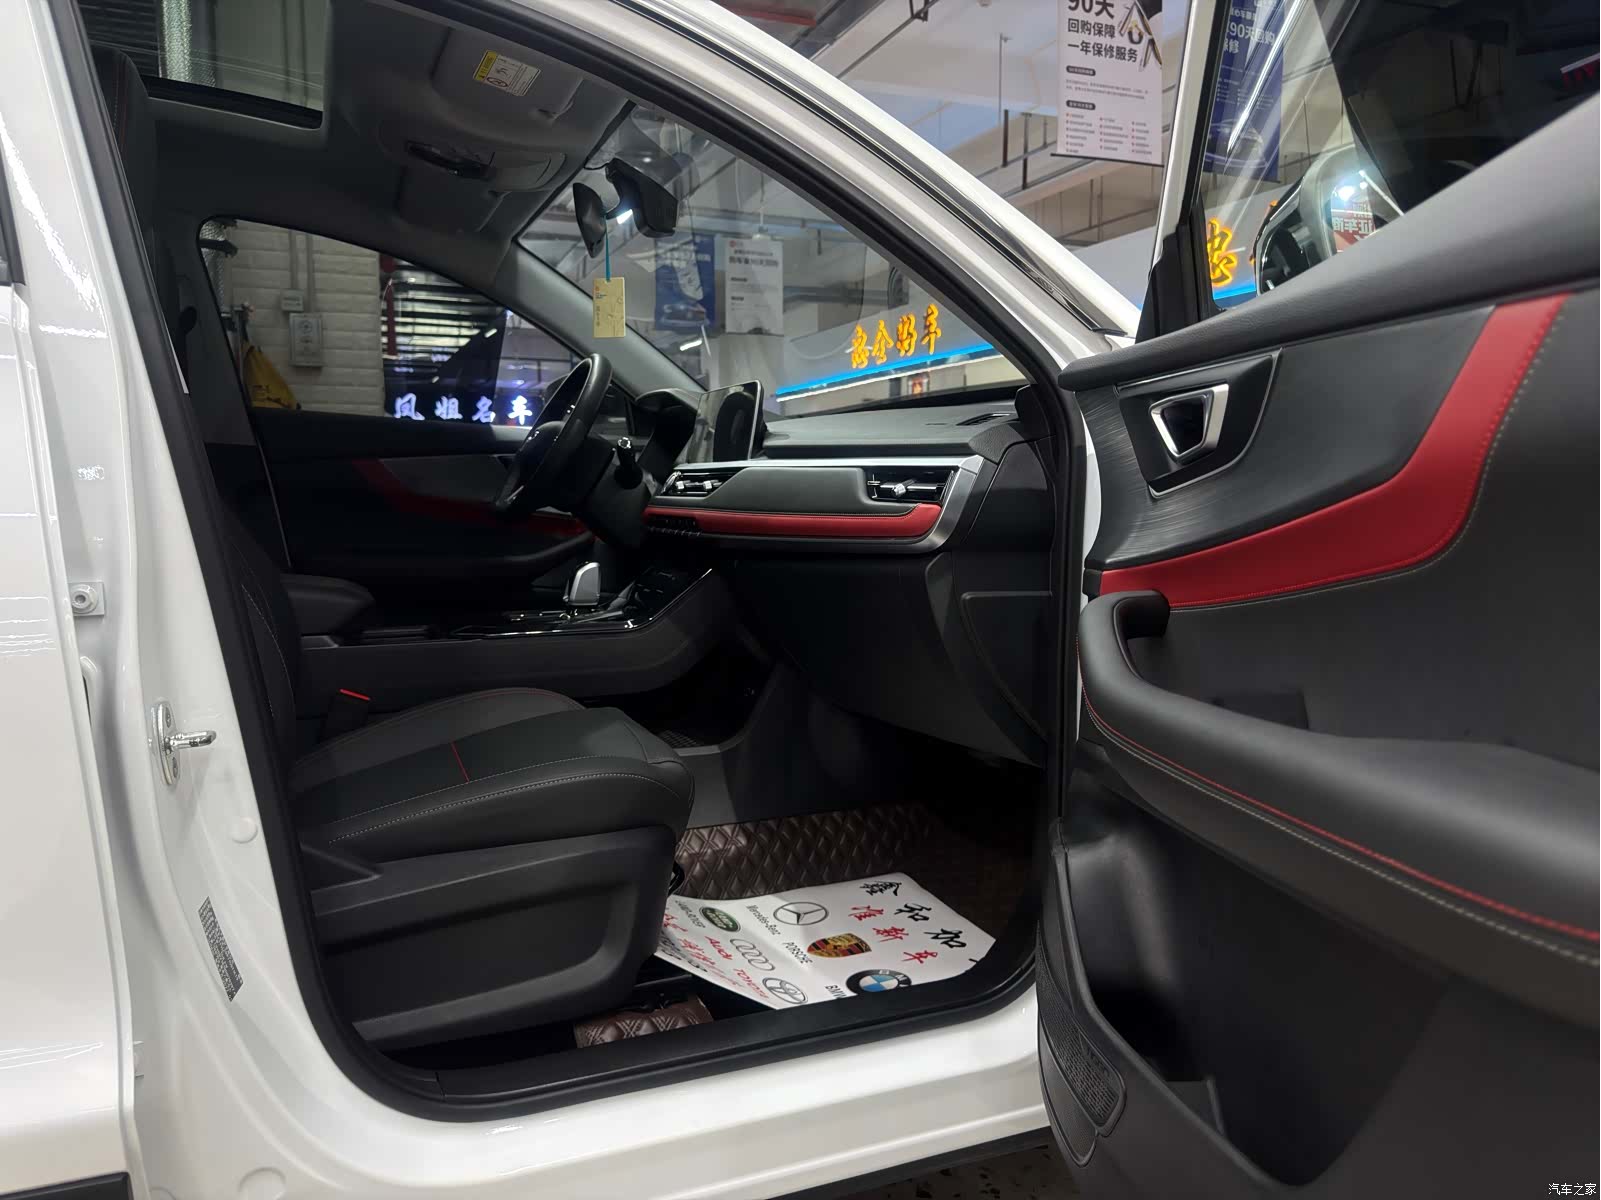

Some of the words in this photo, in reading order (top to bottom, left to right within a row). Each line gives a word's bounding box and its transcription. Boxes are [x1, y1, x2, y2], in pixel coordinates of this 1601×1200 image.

[1067, 18, 1116, 39] 回购保障
[1067, 40, 1138, 63] 一年保修服务
[859, 880, 980, 964] 鑫和加
[704, 936, 733, 960] Audi
